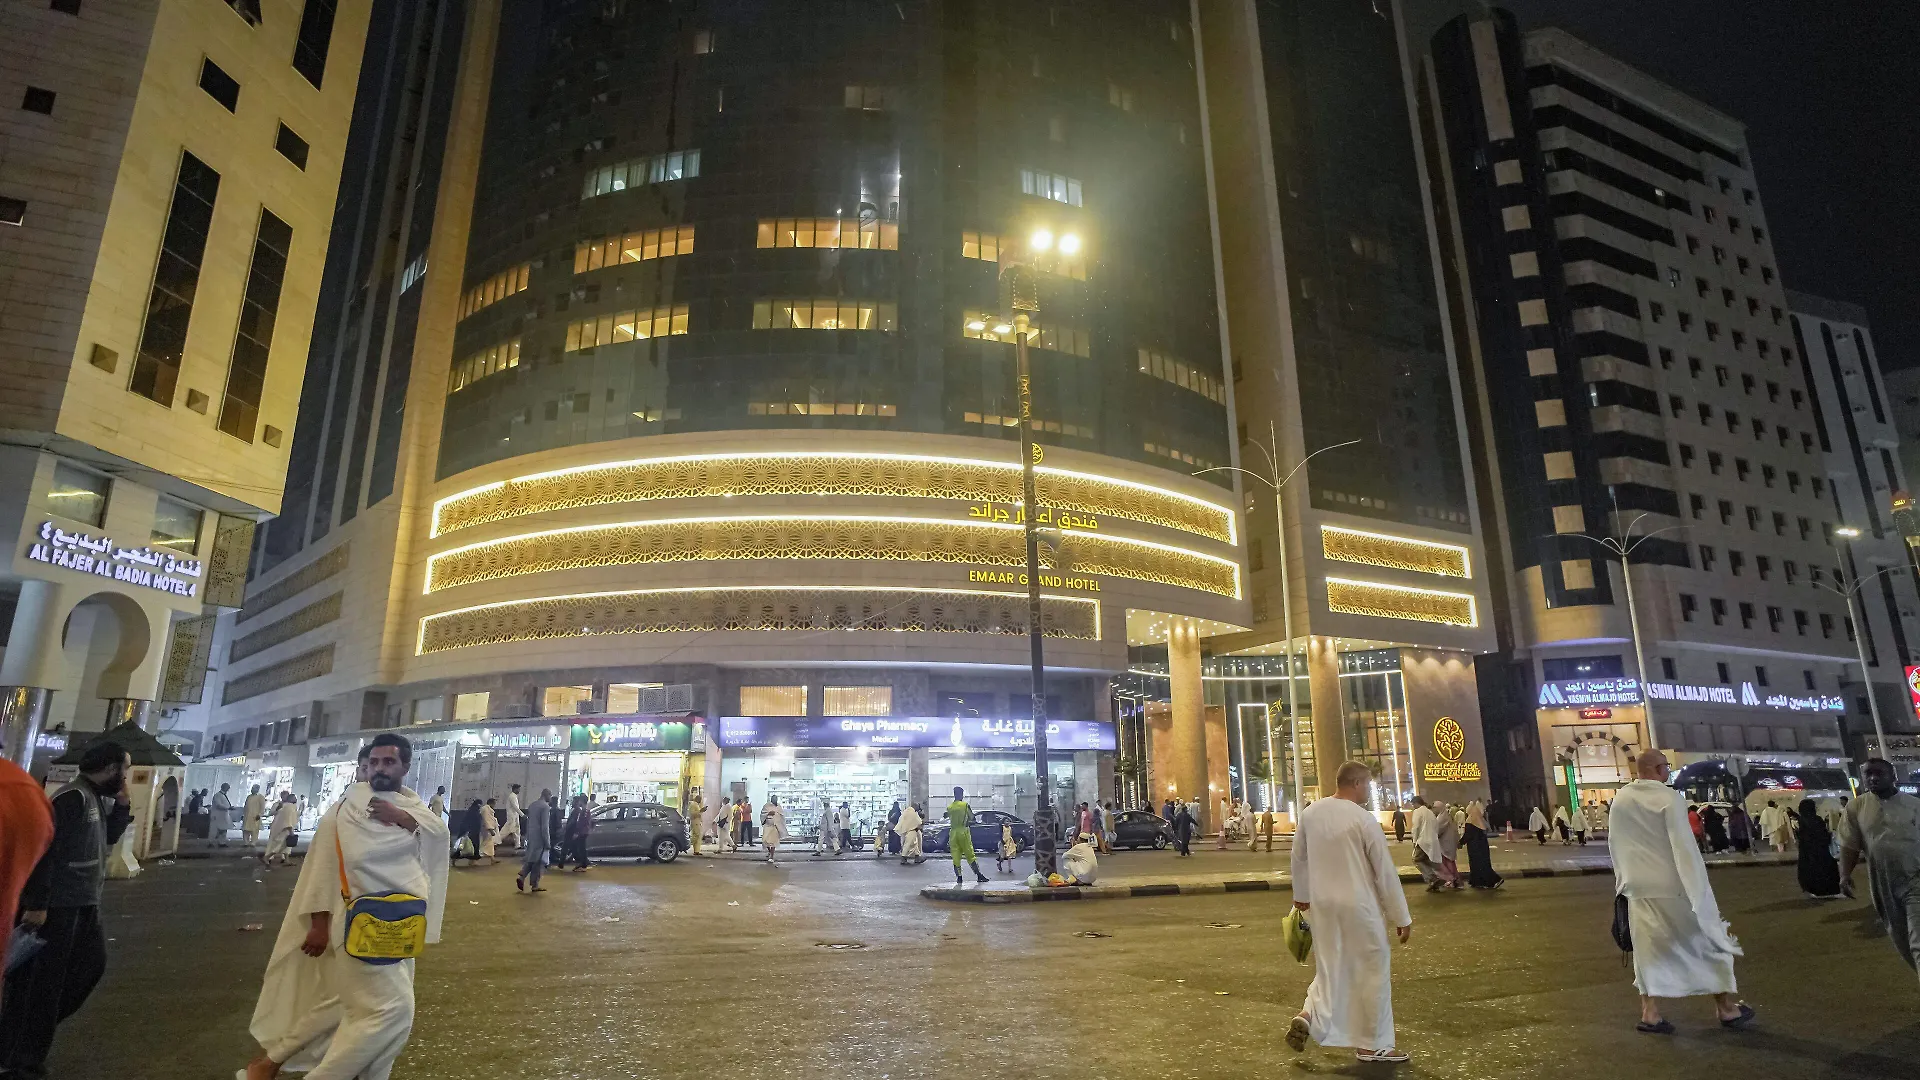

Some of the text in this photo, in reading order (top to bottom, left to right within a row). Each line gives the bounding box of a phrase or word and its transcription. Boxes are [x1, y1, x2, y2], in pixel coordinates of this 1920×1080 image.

[968, 502, 1098, 529] فندق اعار جراند
[52, 526, 113, 553] البديع
[29, 543, 50, 563] AL
[52, 548, 93, 574] FAJER
[96, 559, 113, 578] AL
[114, 564, 151, 588] BADIA
[112, 546, 163, 569] الفجر
[164, 554, 202, 578] فندق
[969, 570, 1101, 592] EMAAR GAND HOTEL
[1567, 691, 1640, 704] YASMIN ALMAJD HOTEL
[1675, 684, 1709, 702] ALMAJD
[1709, 687, 1737, 704] HOTEL
[1821, 694, 1844, 710] فندق
[876, 720, 929, 733] Pharmacy
[871, 735, 899, 744] Medical
